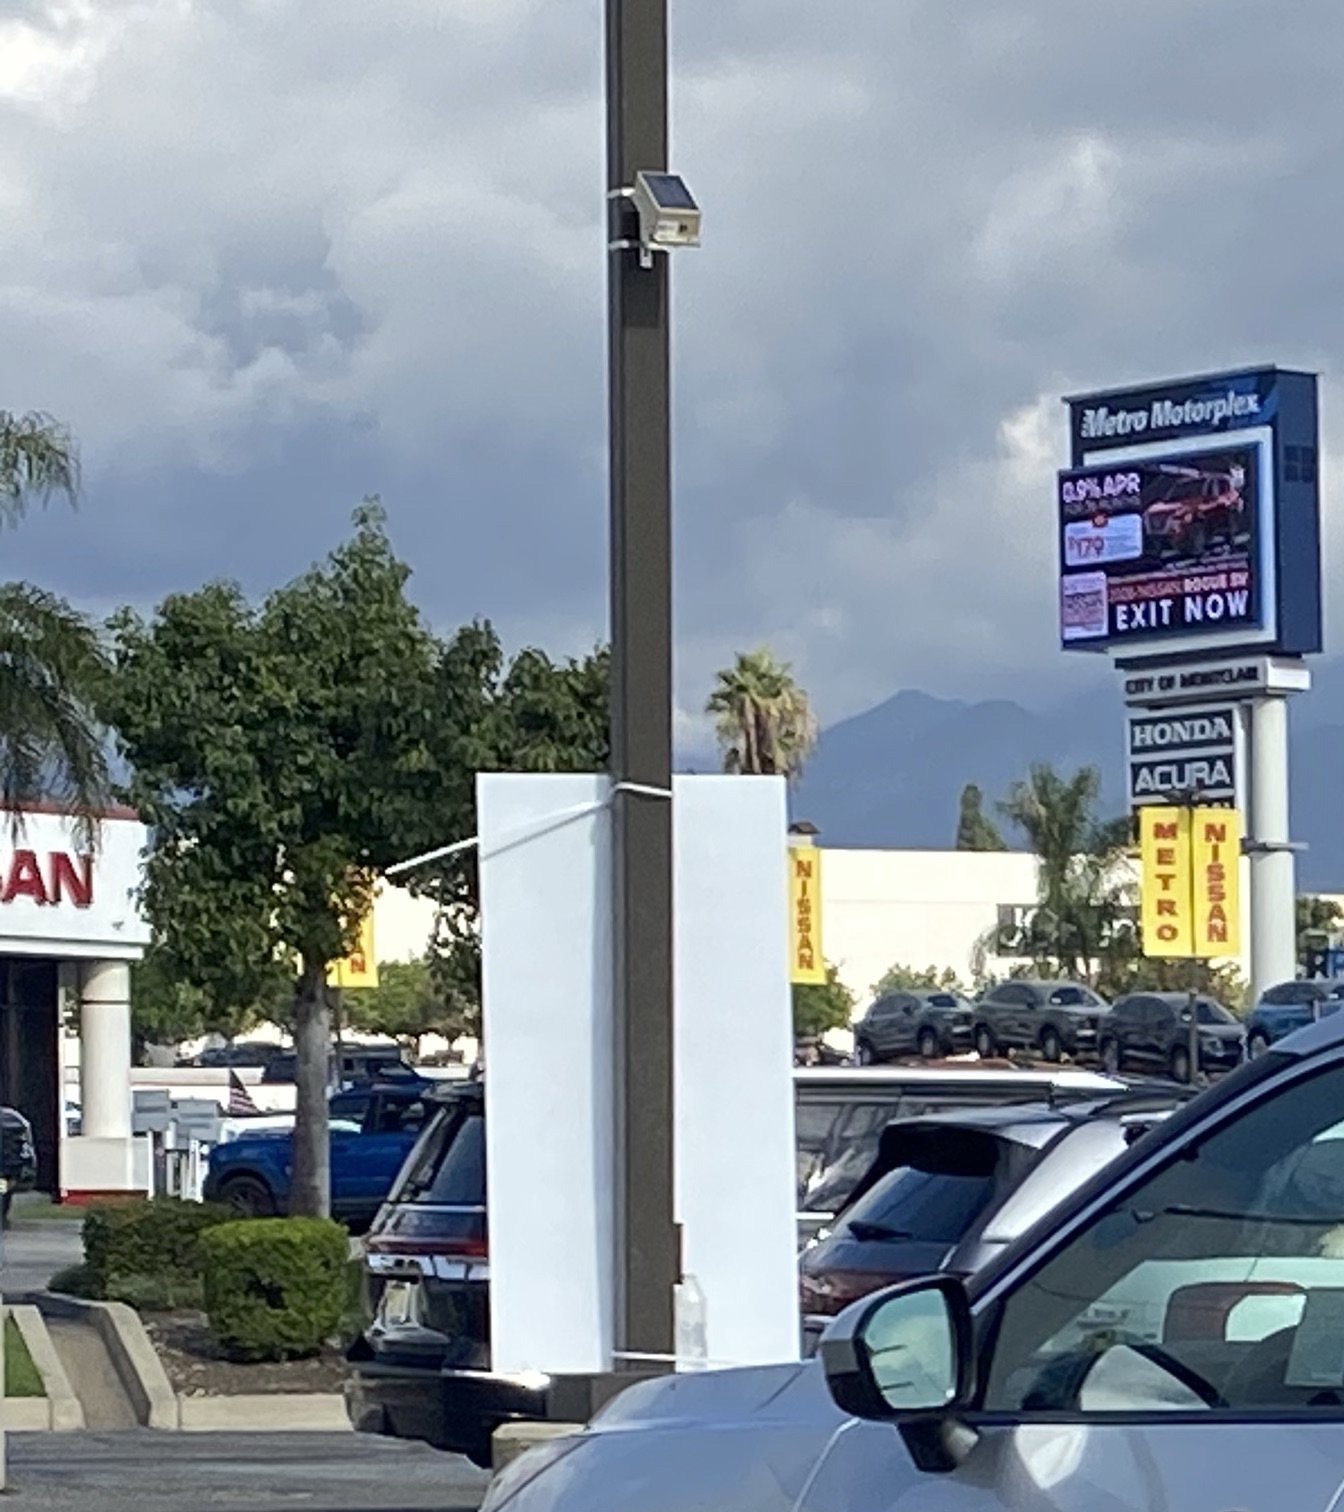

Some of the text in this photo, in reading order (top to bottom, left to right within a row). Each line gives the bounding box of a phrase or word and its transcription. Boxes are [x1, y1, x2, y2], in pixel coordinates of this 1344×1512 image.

[1080, 391, 1261, 438] Metro Motorplex
[1102, 472, 1140, 497] APR
[1116, 599, 1175, 631] EXIT
[1184, 589, 1249, 622] NOW
[1126, 676, 1154, 694] CITY
[1157, 675, 1175, 690] OF
[1131, 716, 1232, 747] HONDA
[1134, 760, 1232, 793] ACURA
[0, 848, 95, 909] AN
[1153, 823, 1178, 942] METRO
[1204, 824, 1227, 943] NISSAN
[796, 860, 814, 970] NISSAN
